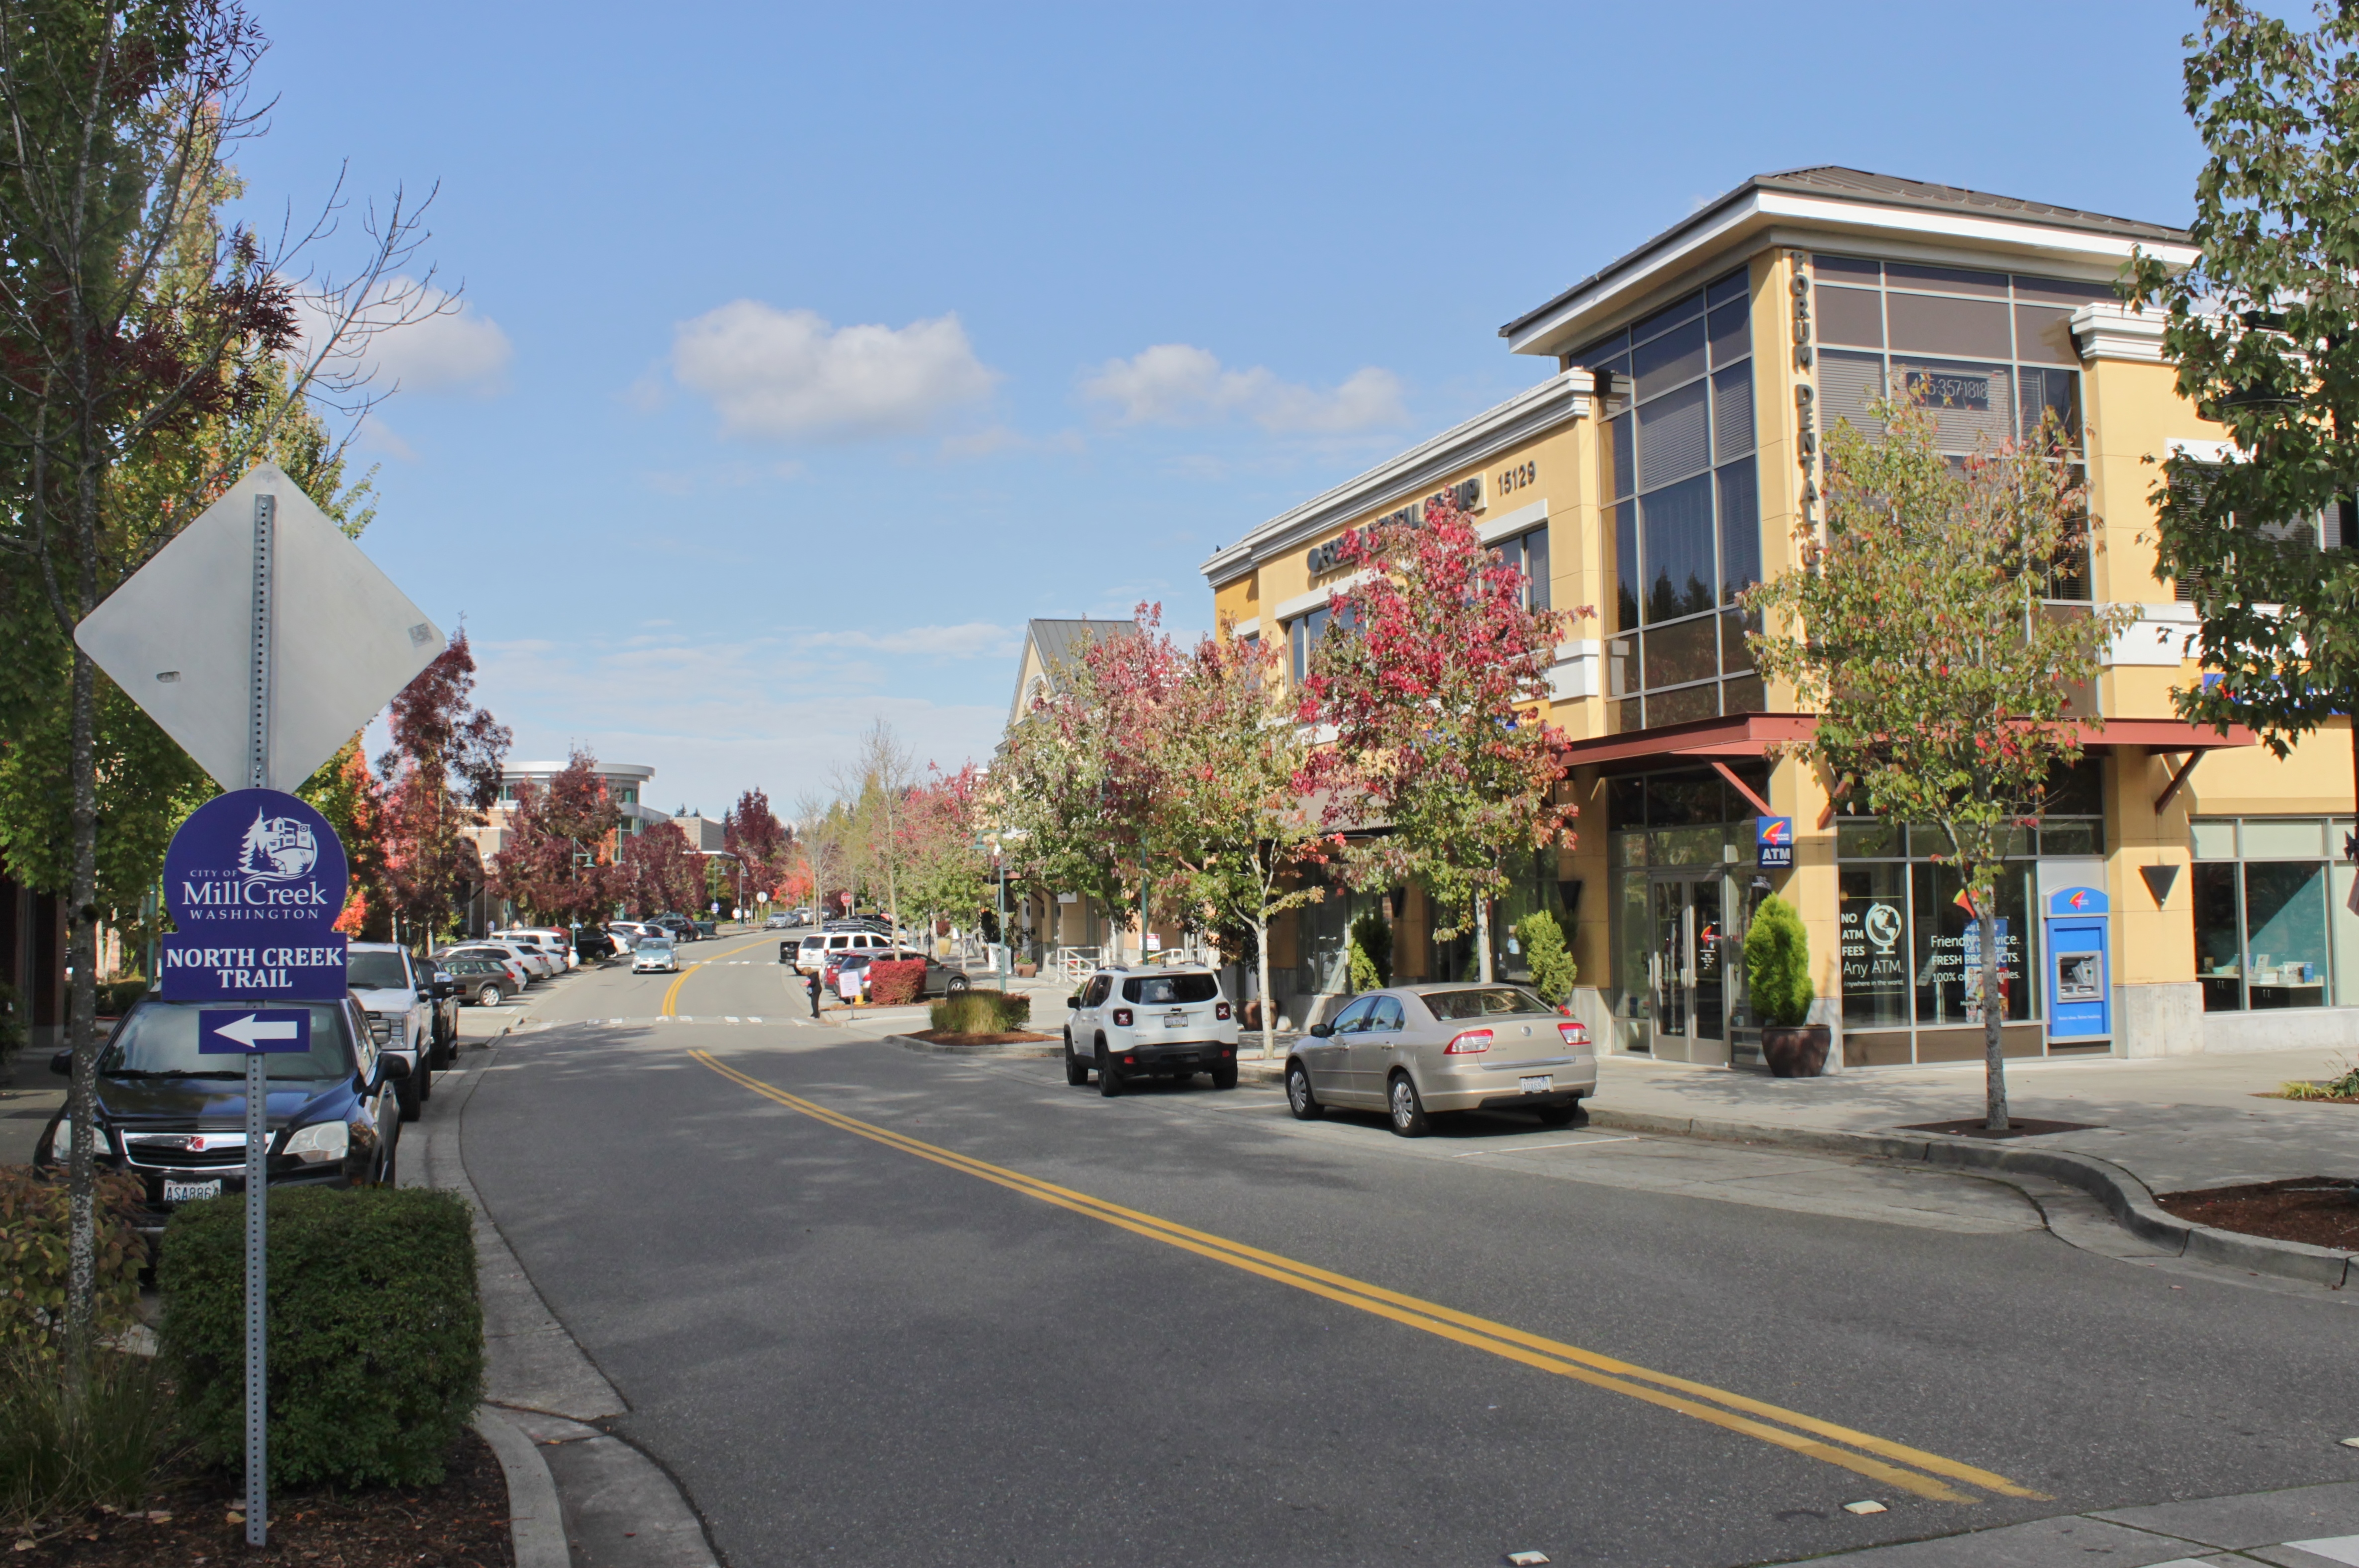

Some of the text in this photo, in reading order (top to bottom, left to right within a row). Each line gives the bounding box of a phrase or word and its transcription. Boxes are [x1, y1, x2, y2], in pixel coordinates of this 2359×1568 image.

[1789, 251, 1813, 375] FORUM
[1909, 378, 1988, 398] 5-357-1818
[1794, 384, 1819, 528] DENTAL
[1498, 460, 1536, 497] 15129
[1321, 527, 1367, 567] FOR
[1762, 848, 1790, 860] ATM
[190, 909, 319, 919] WASHINGTON
[1841, 913, 1858, 924] NO
[1842, 929, 1865, 940] ATM
[1994, 933, 2020, 945] vice.
[166, 948, 343, 968] NORTH CREEK
[1842, 946, 1866, 957] FEES
[1931, 952, 2021, 966] FRESH PROCTS.
[1843, 960, 1904, 978] Any ATM.
[1932, 972, 1956, 982] 100%
[1996, 970, 2021, 980] miles.
[217, 969, 293, 988] TRAIL
